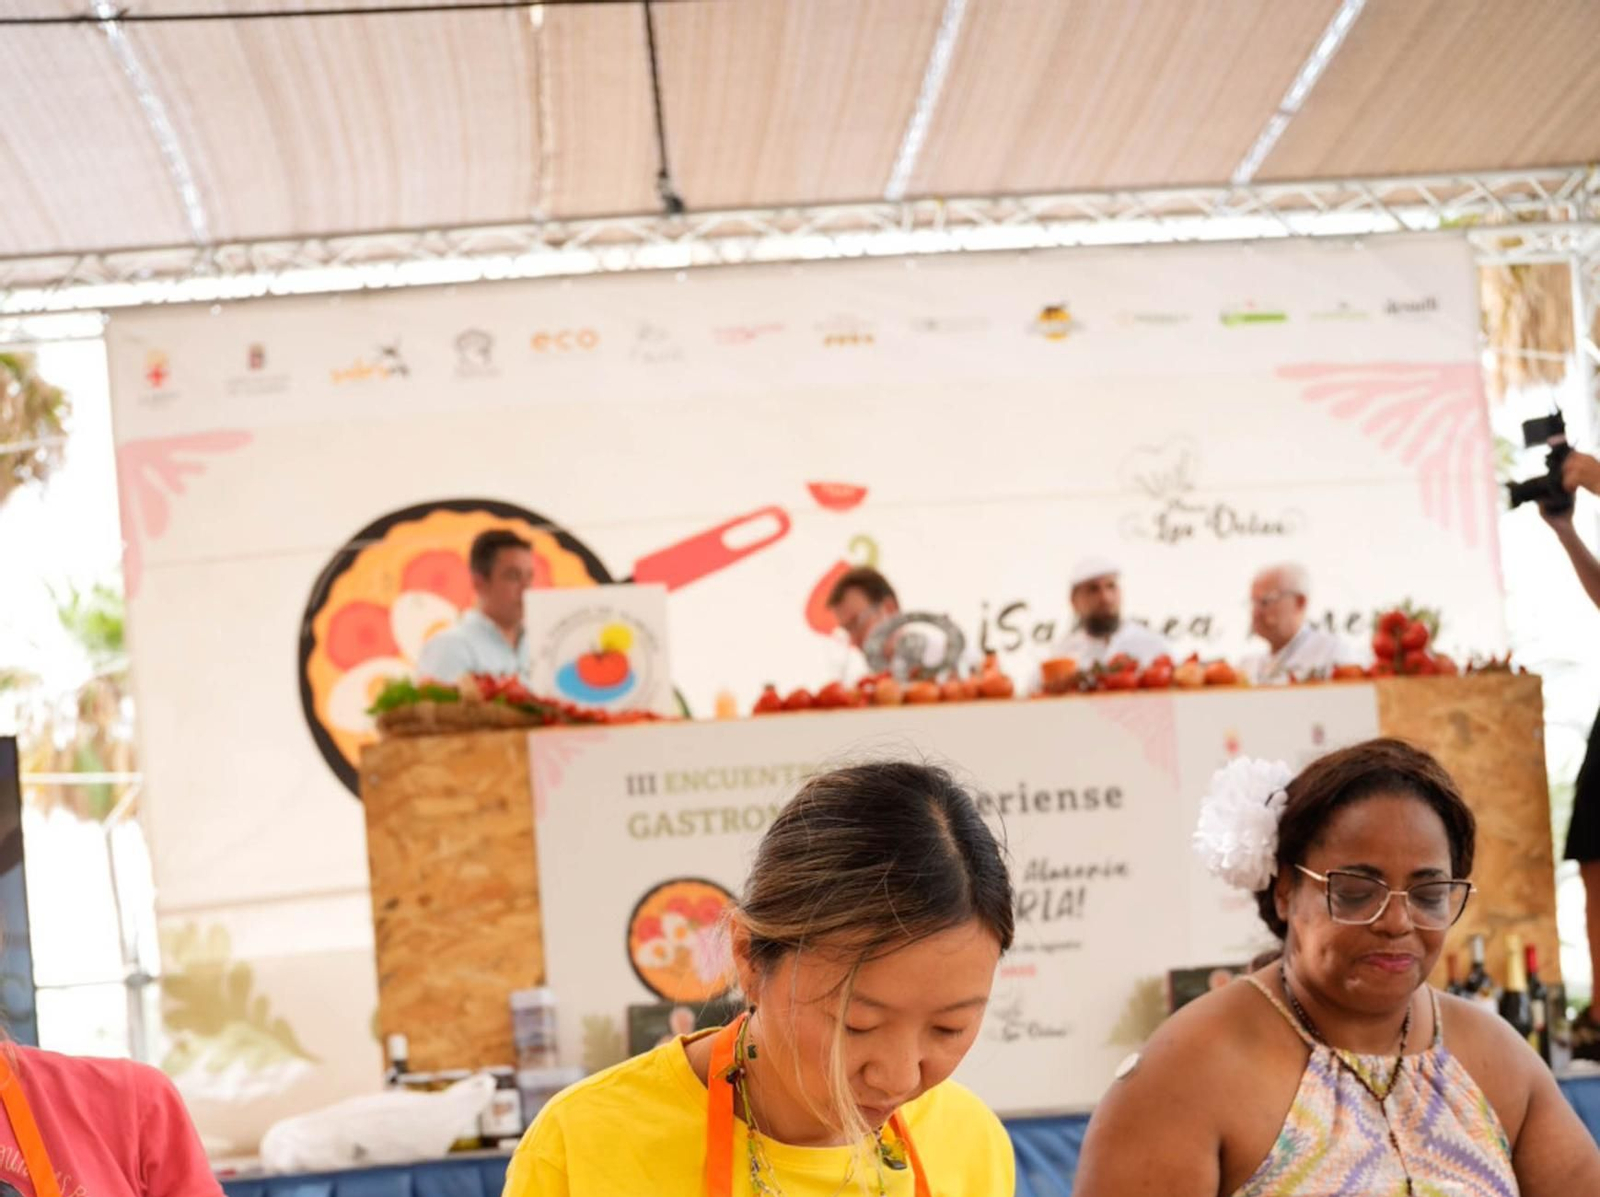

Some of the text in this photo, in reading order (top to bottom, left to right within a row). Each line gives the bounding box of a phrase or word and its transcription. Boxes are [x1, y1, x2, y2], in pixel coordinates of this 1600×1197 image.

[530, 328, 601, 352] eco
[626, 772, 656, 796] III
[976, 782, 1123, 815] eriense
